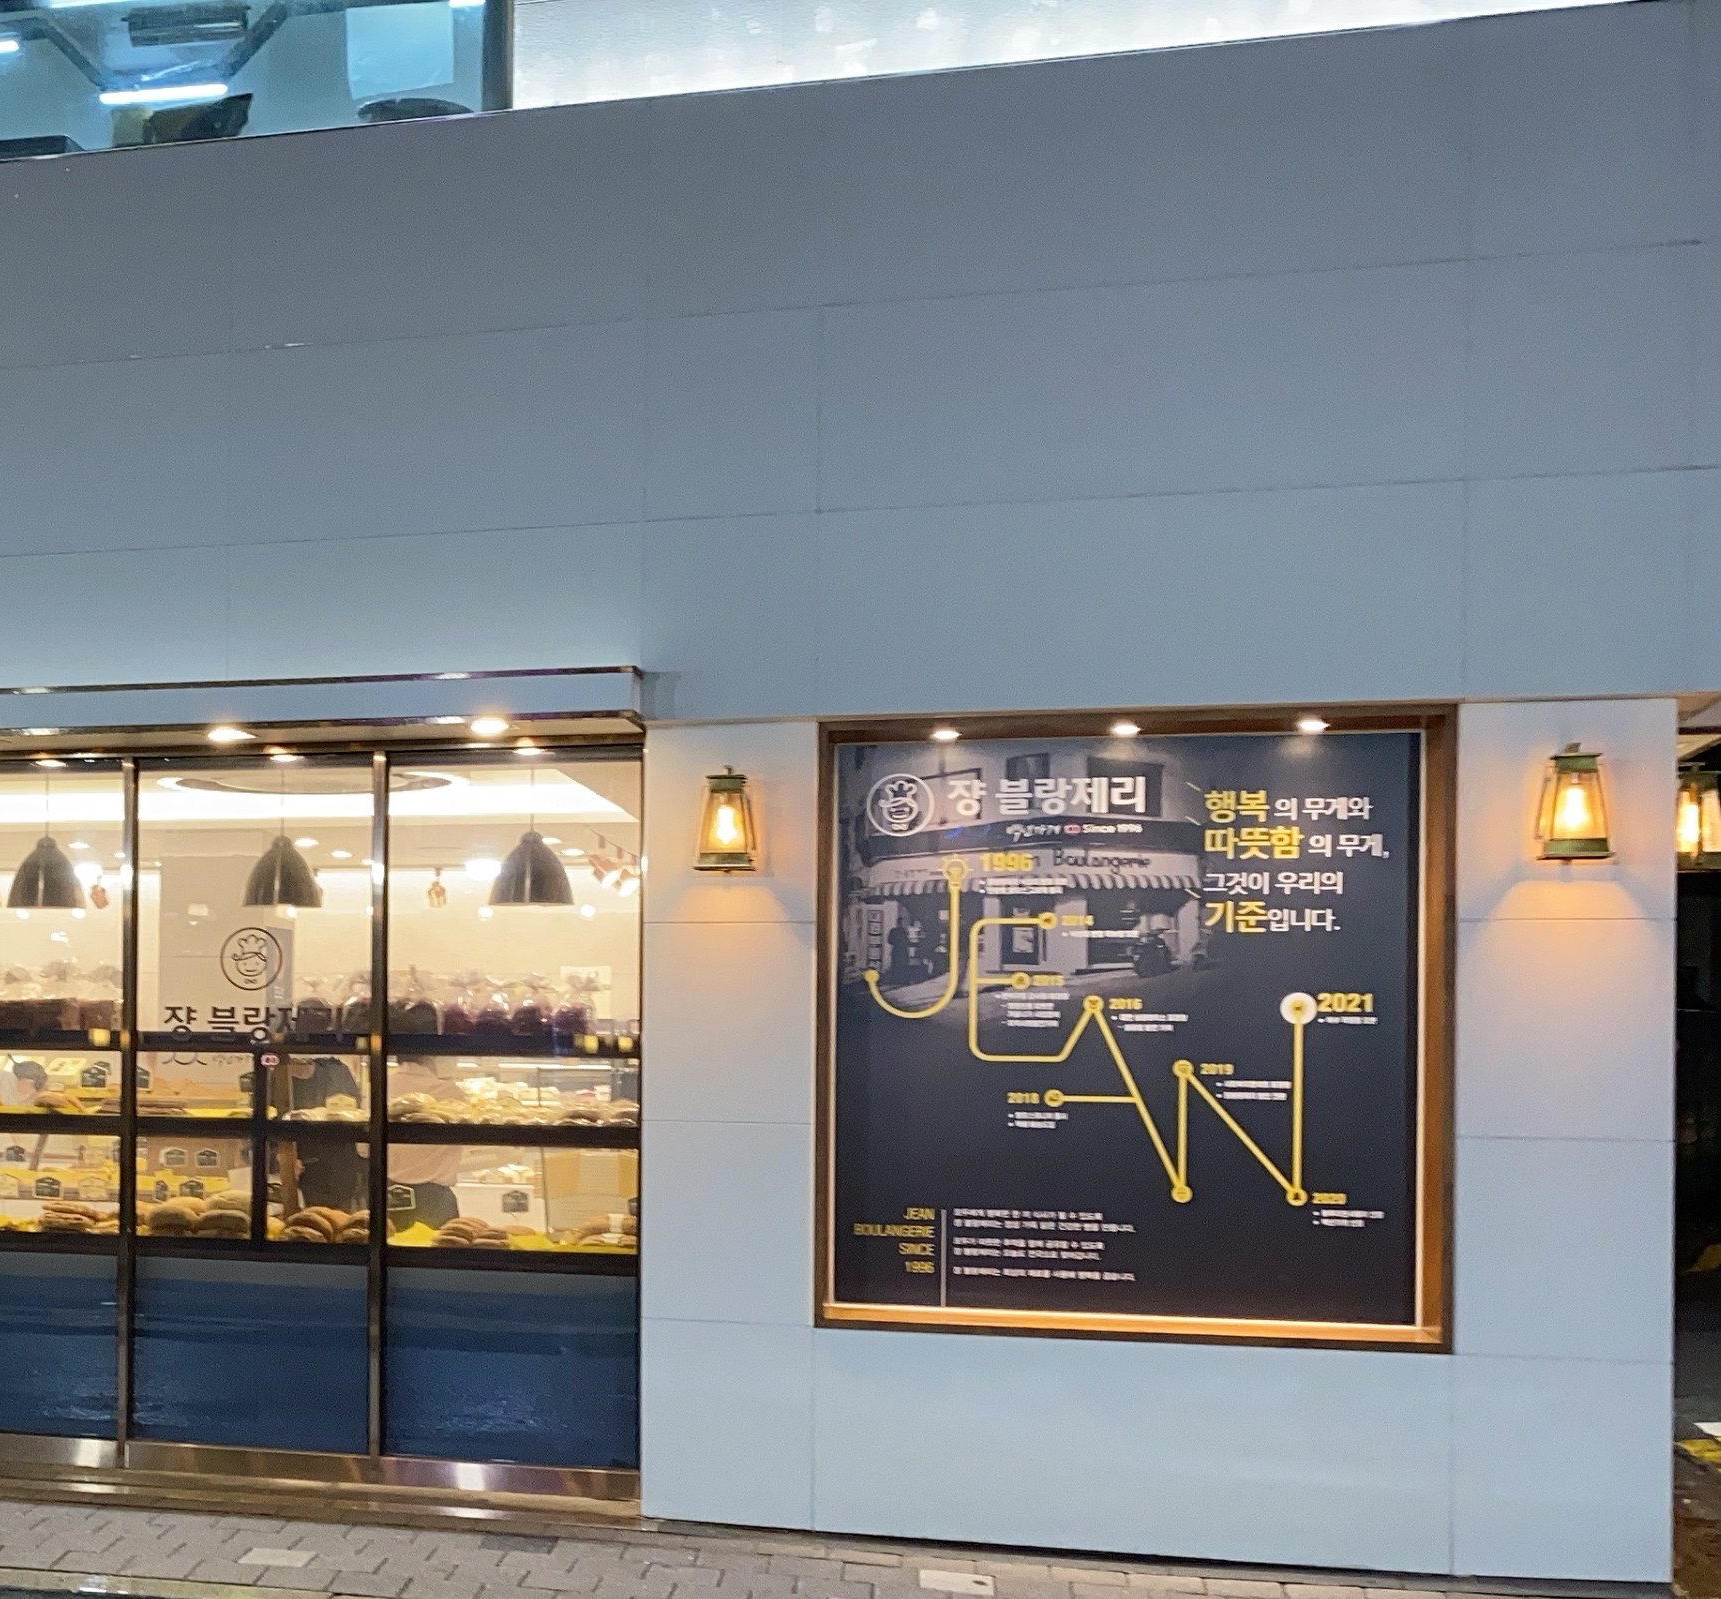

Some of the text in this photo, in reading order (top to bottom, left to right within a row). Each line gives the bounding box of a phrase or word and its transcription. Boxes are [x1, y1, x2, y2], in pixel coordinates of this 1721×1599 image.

[947, 776, 1147, 816] 쟝 블랑제리
[1204, 789, 1374, 823] 행복 의 무게와
[1082, 824, 1117, 834] Since
[1204, 825, 1305, 859] 따뜻함
[1308, 833, 1332, 858] 의
[980, 852, 1034, 872] 1996
[1203, 871, 1344, 895] 그것이 우리의
[1204, 900, 1342, 933] 기준입니다.
[1316, 992, 1374, 1013] 2021
[164, 1005, 198, 1042] 쟝
[903, 1207, 936, 1220] JEAN
[898, 1242, 936, 1257] SINCE
